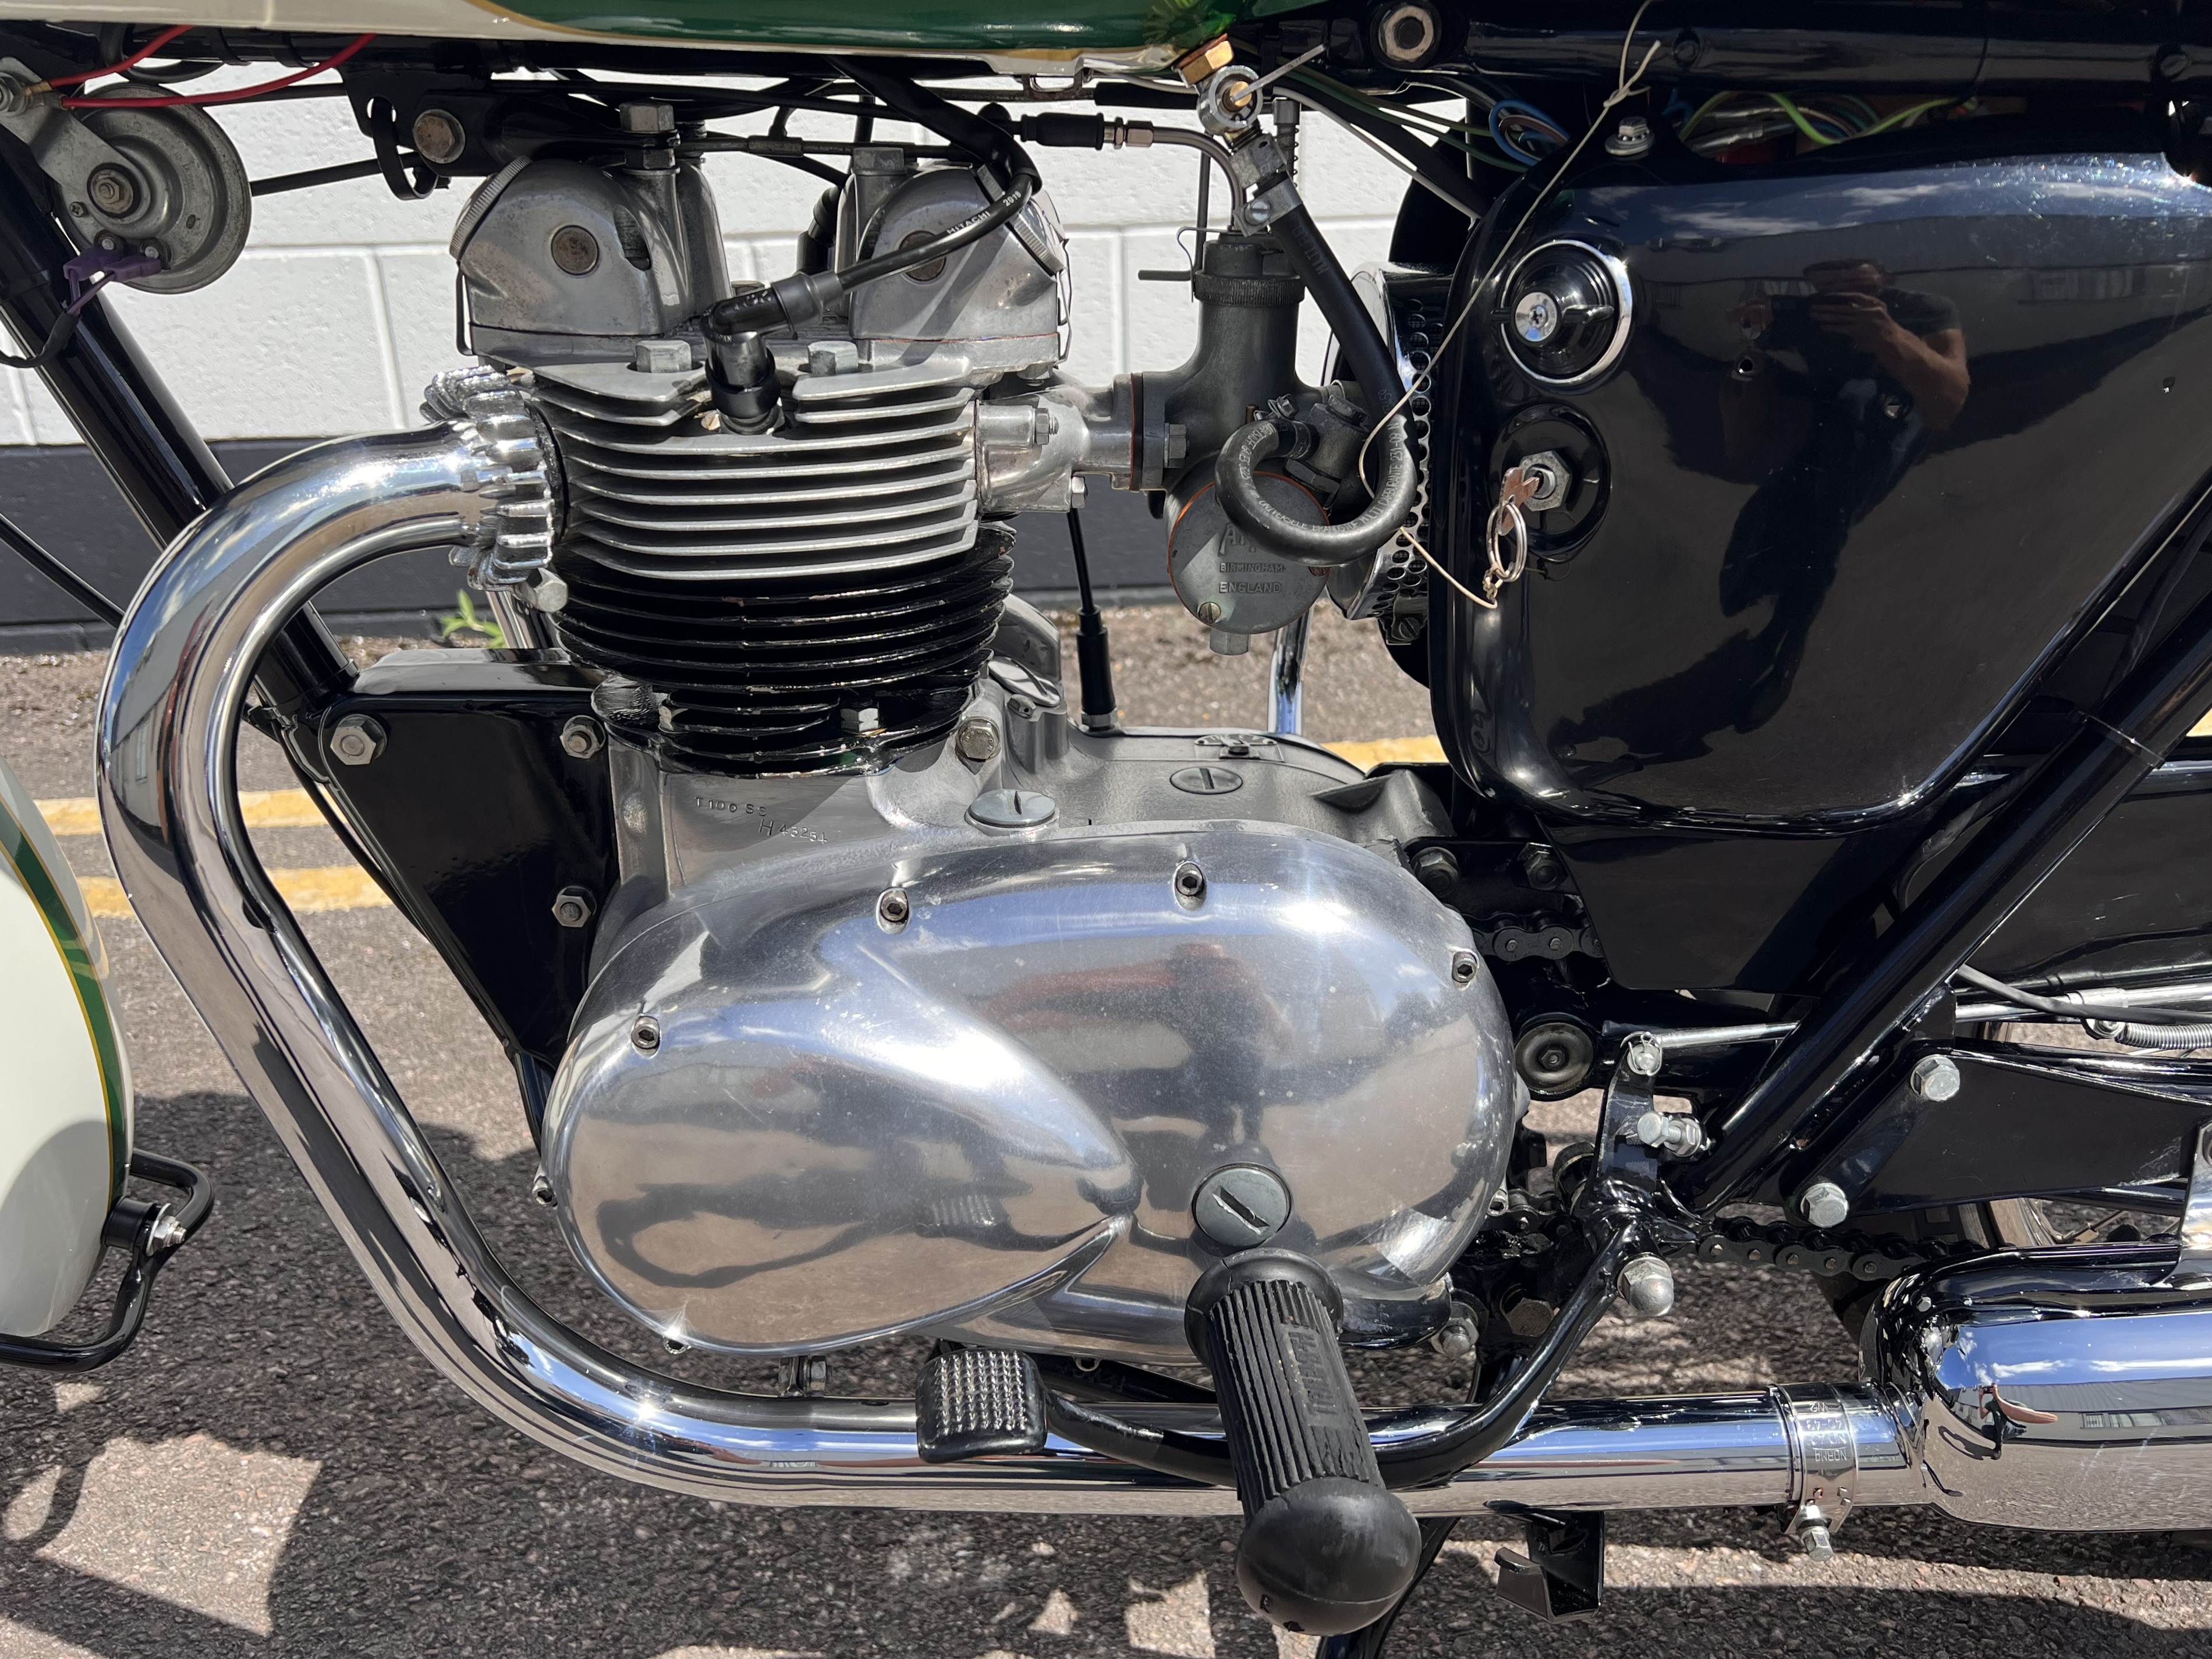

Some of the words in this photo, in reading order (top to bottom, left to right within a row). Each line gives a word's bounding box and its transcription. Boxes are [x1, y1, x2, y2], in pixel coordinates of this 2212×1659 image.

[947, 210, 991, 235] HITACHI
[1219, 581, 1282, 594] ENGLAND
[1814, 1449, 1848, 1462] NORMA
